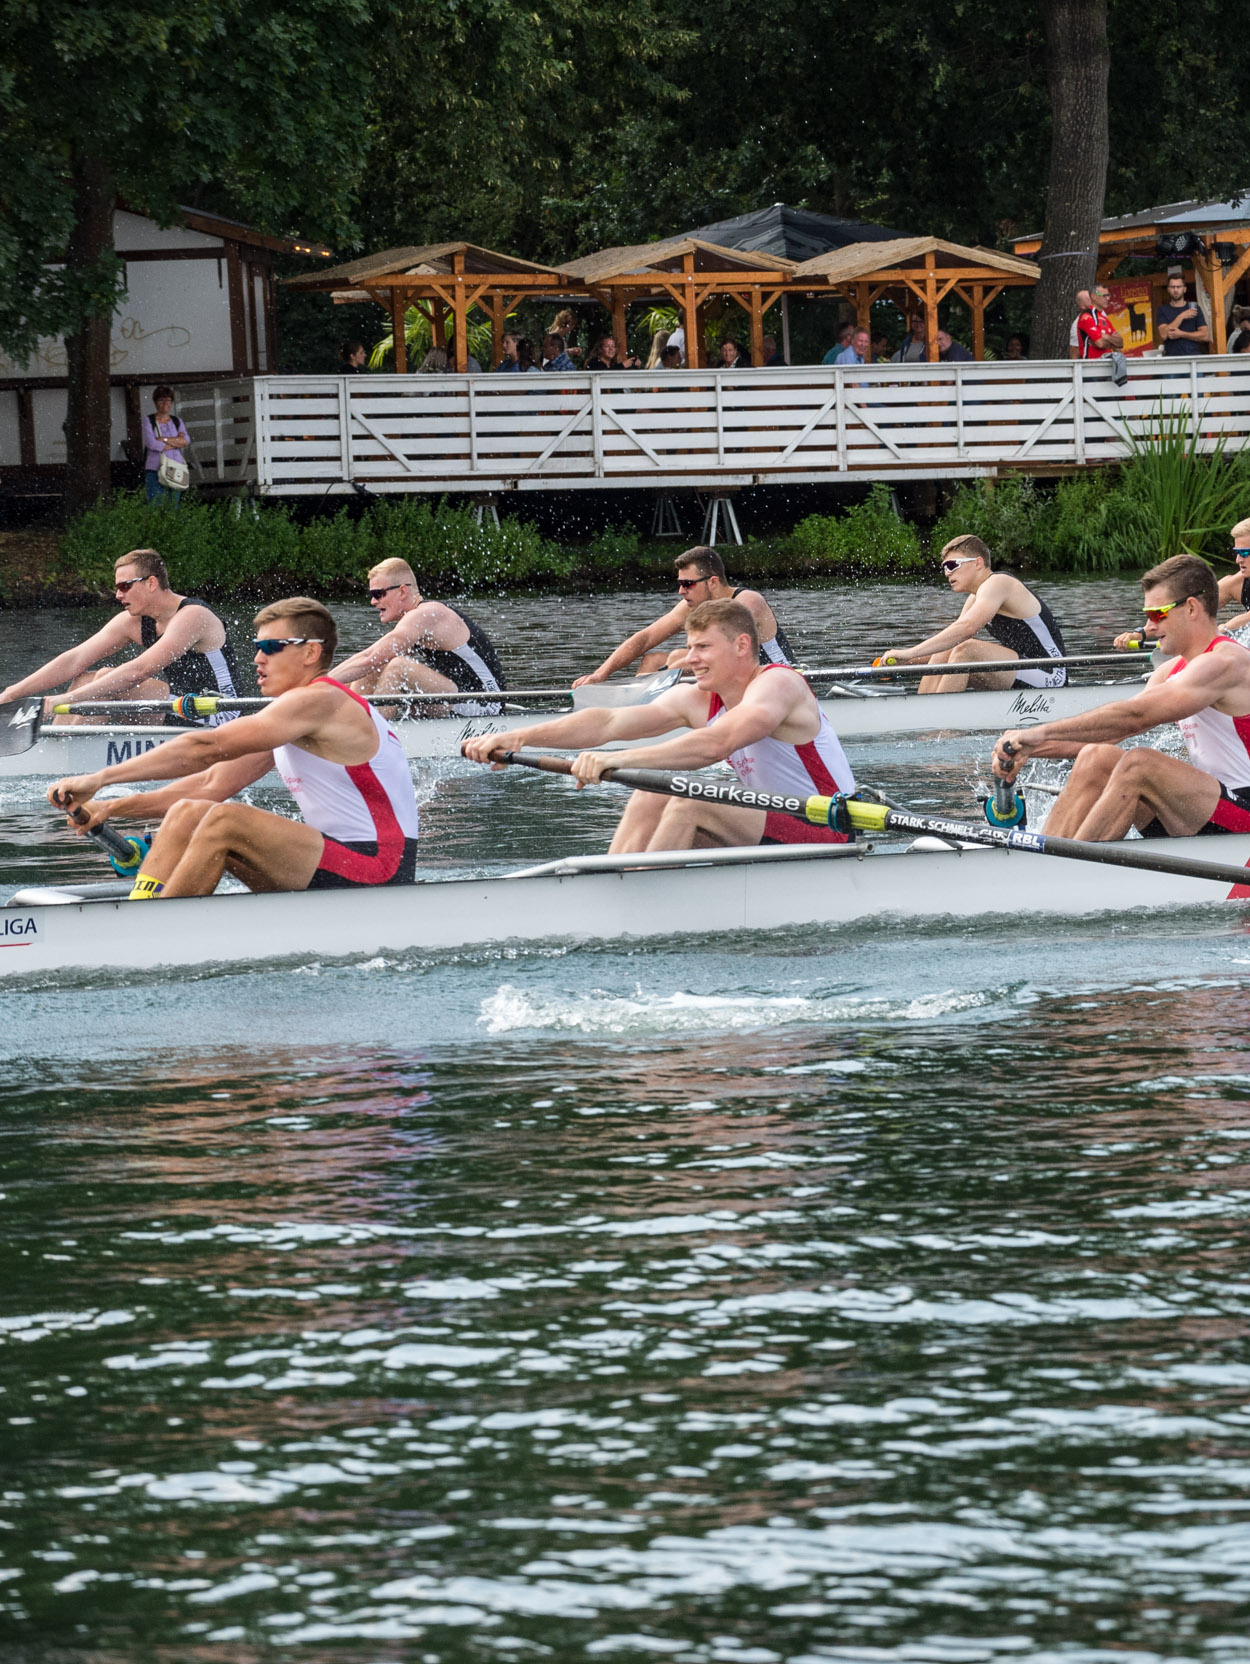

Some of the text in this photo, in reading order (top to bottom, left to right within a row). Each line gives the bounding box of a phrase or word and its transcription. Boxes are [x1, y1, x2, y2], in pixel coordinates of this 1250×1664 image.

[670, 776, 800, 811] Sparkasse
[890, 814, 926, 828] STARK.
[928, 820, 979, 837] SCHNELL.
[1012, 832, 1040, 846] RBL
[0, 917, 37, 936] IGA
